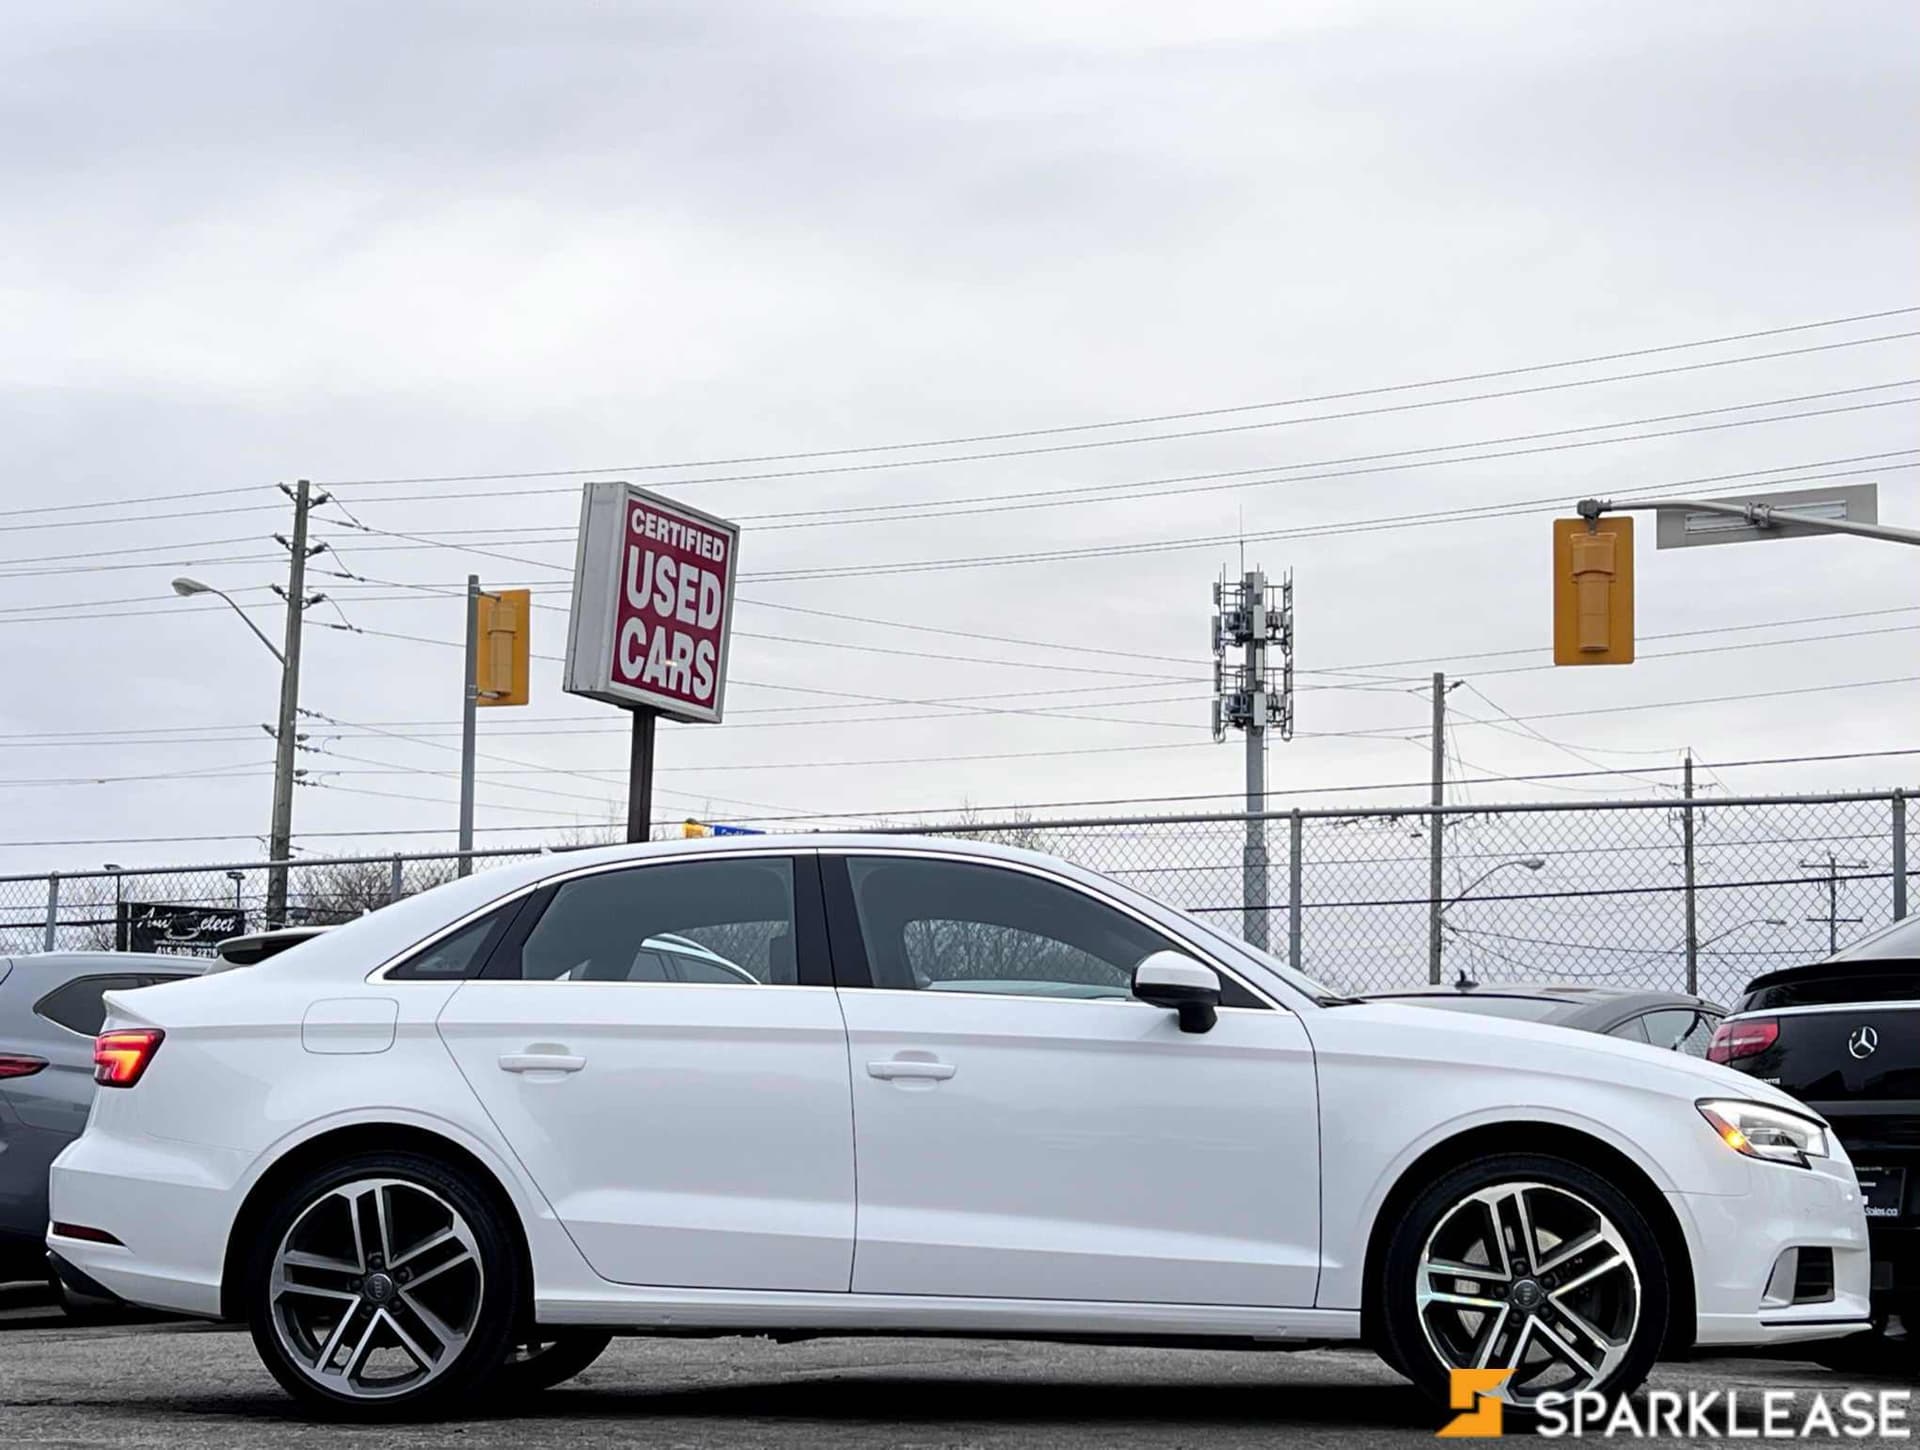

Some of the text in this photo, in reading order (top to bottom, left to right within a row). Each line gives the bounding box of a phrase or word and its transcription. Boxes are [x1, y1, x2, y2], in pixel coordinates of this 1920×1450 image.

[631, 508, 724, 562] CERTIFIED
[626, 545, 722, 630] USED
[619, 616, 715, 700] CARS
